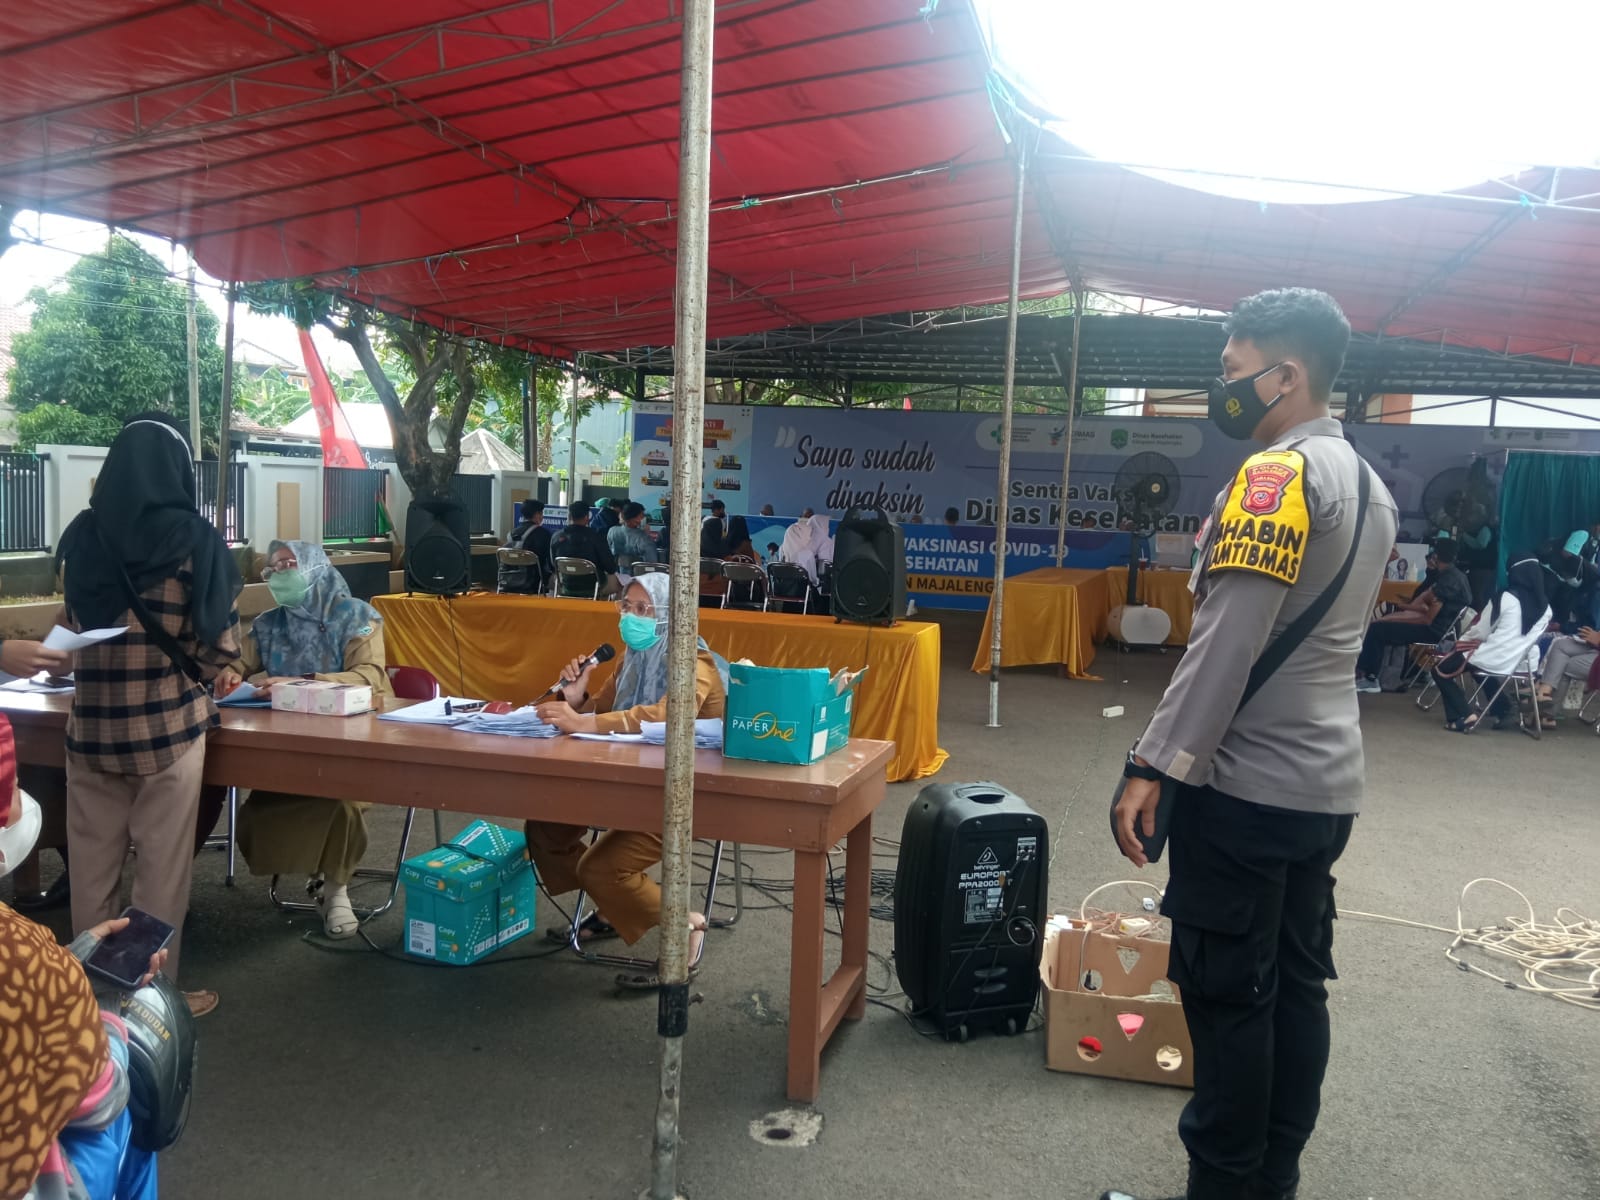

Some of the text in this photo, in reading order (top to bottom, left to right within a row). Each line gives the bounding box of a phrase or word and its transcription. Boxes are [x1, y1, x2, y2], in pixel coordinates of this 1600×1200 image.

[793, 434, 936, 478] Saya sudah
[826, 480, 925, 514] divaksin
[1217, 518, 1304, 555] HABIN
[906, 556, 979, 573] SEHATAN
[1209, 541, 1299, 580] AMTIBMAS
[917, 576, 994, 594] MAJALENG
[732, 719, 769, 732] PAPER
[405, 867, 420, 879] Copy
[438, 926, 456, 937] Copy
